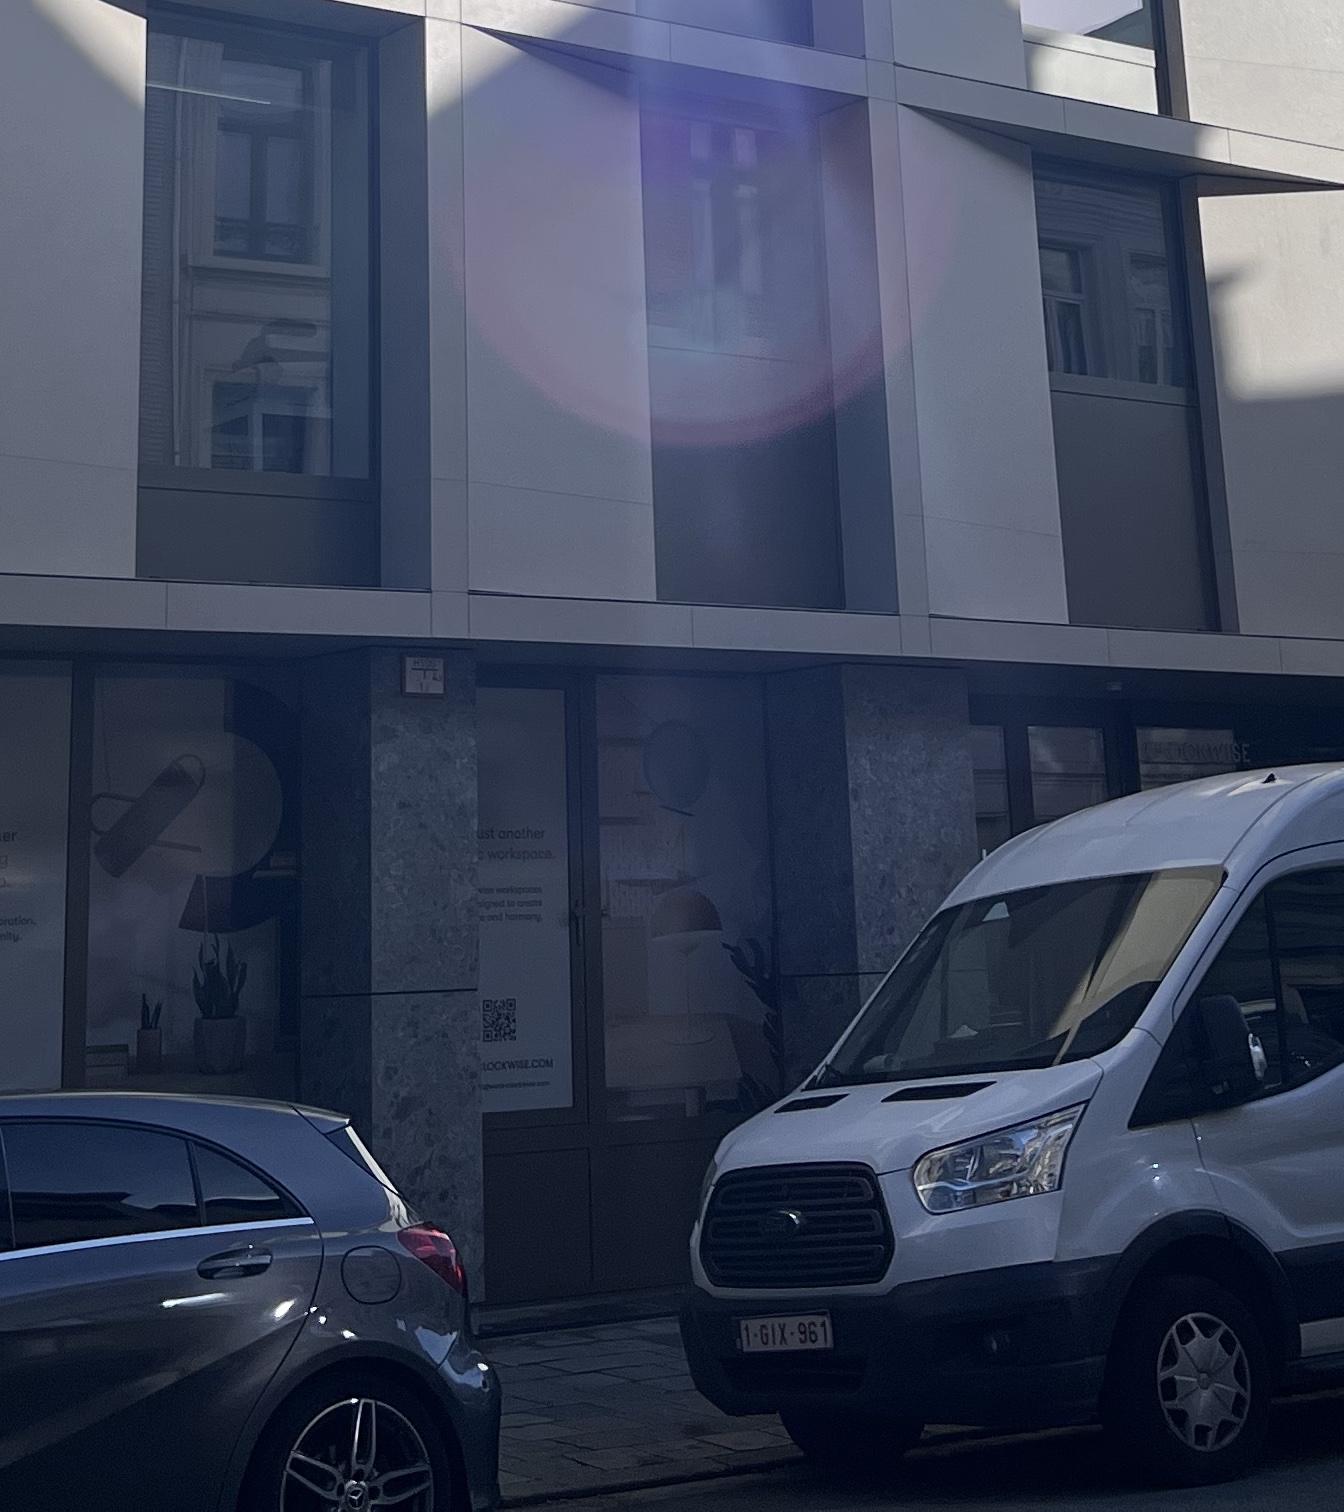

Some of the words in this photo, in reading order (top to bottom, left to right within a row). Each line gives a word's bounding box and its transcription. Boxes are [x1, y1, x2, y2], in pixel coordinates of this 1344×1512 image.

[477, 827, 495, 840] ust
[498, 826, 545, 840] another
[481, 1059, 553, 1072] LOCKWISE.COM
[744, 1320, 828, 1347] 1-GIX-961
